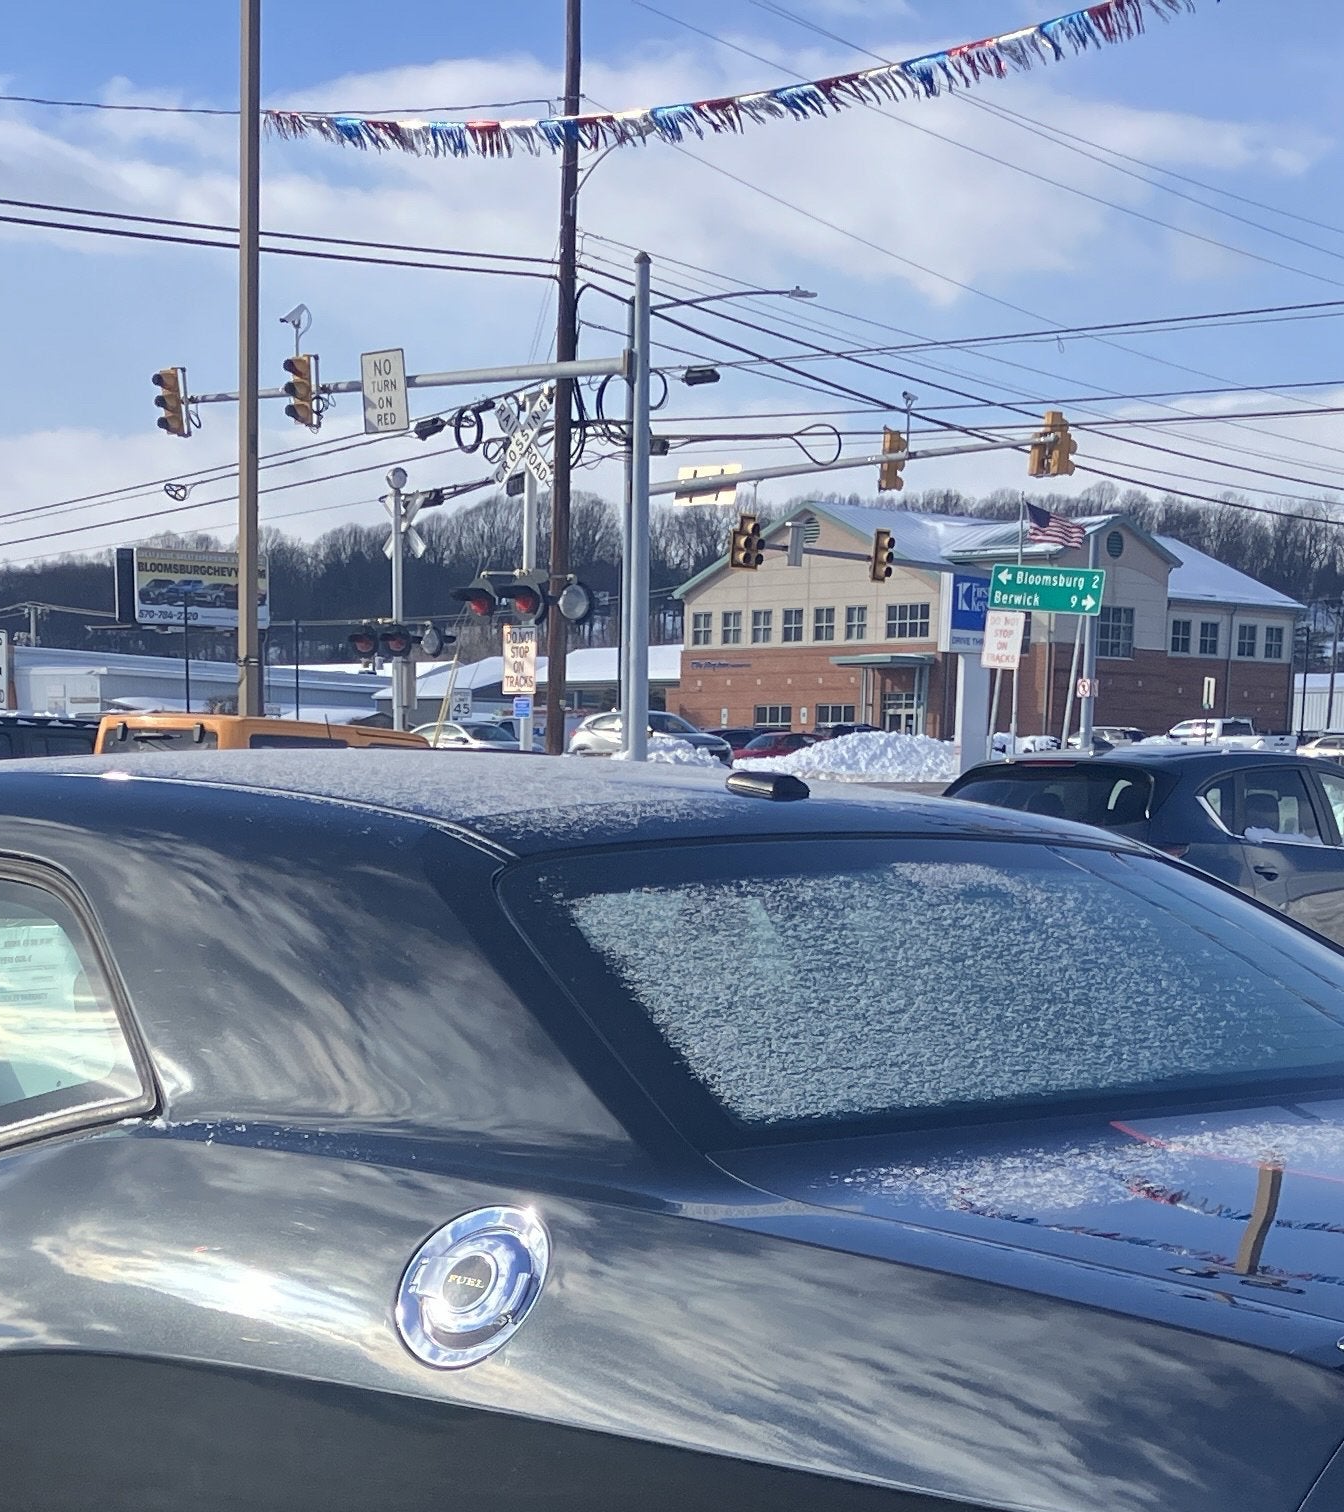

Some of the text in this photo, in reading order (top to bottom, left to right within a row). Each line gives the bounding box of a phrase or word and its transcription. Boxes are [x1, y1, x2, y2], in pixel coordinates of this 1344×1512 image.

[373, 358, 392, 377] NO
[371, 378, 397, 394] TURN
[378, 395, 393, 410] ON
[376, 411, 397, 427] RED
[496, 399, 548, 483] CROSSING
[525, 444, 547, 481] ROAD
[1016, 571, 1099, 590] Bloomsburg 2
[993, 590, 1078, 608] Berwick 9
[990, 615, 1020, 626] DO NOT
[506, 631, 534, 645] DO NOT
[993, 629, 1014, 639] STOP
[510, 646, 530, 659] STOP
[997, 641, 1008, 651] ON
[986, 653, 1015, 664] TRACKS
[513, 661, 524, 674] ON
[505, 675, 534, 688] TRACKS
[454, 704, 470, 715] 45
[447, 1274, 484, 1289] FUEL
